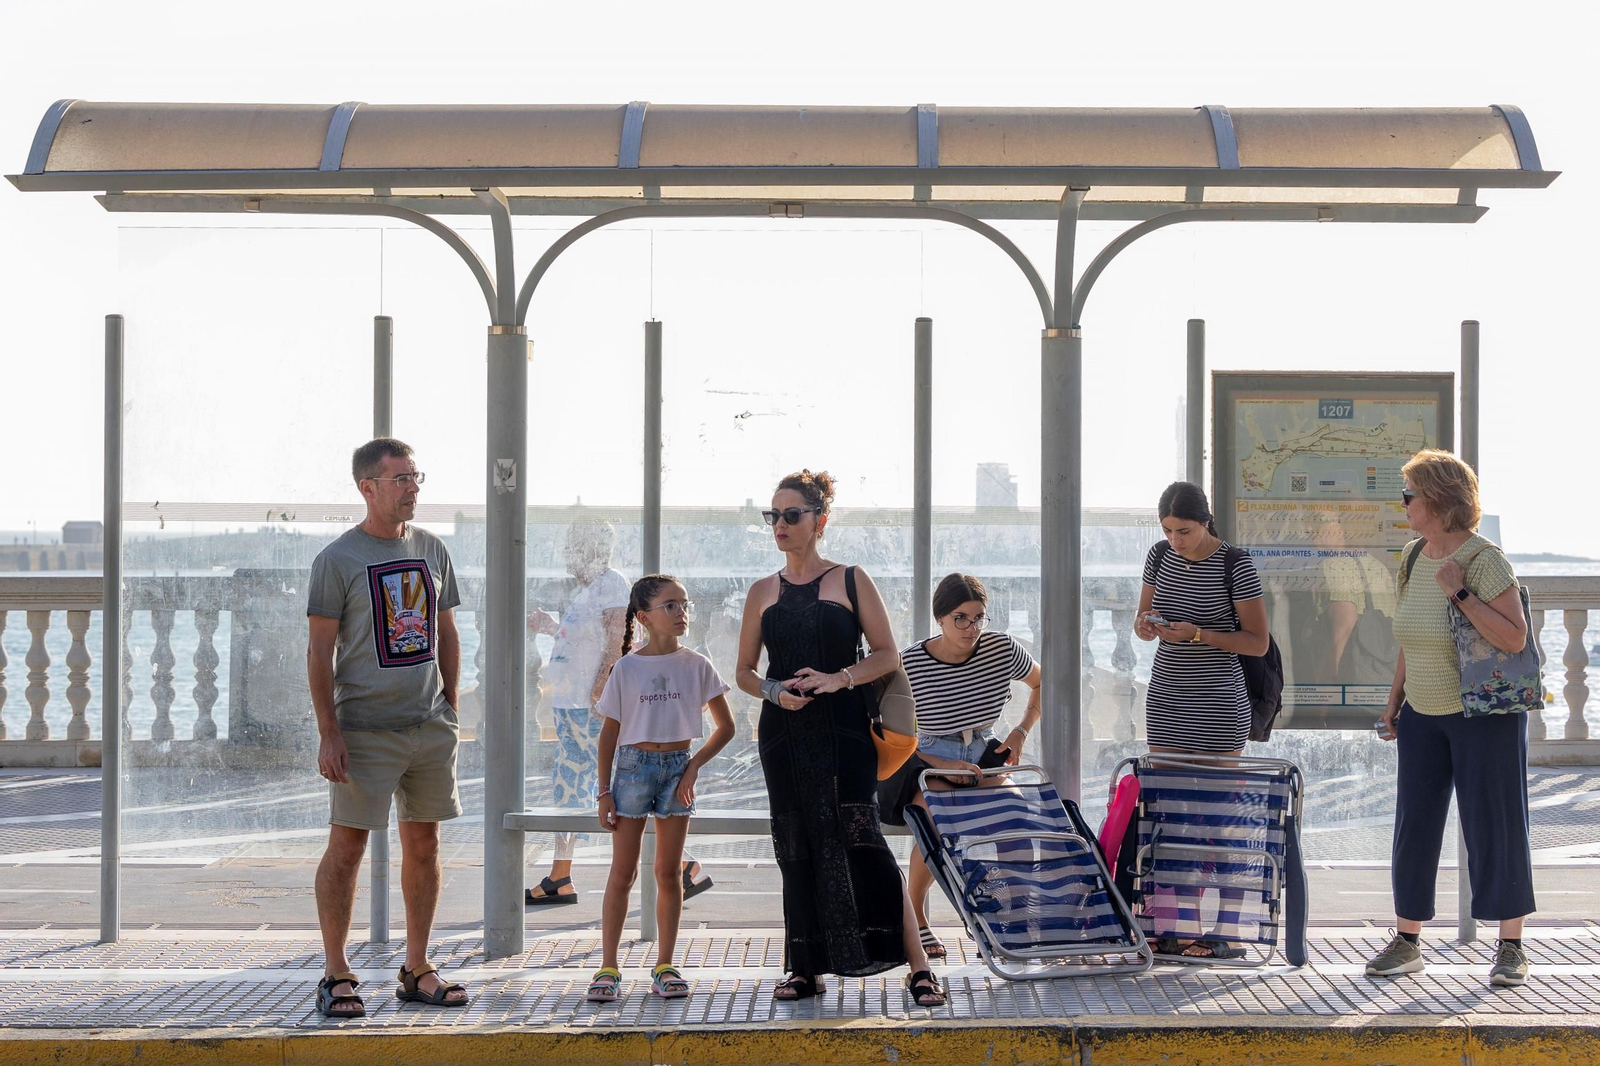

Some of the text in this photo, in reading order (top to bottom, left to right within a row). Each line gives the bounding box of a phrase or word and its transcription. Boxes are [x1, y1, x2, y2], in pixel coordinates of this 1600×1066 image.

[1321, 405, 1351, 417] 1207
[1272, 503, 1297, 511] ESPAÑA
[1317, 549, 1339, 557] SIMÓN
[1340, 549, 1368, 557] BOLÍVAR
[639, 691, 681, 705] superstar
